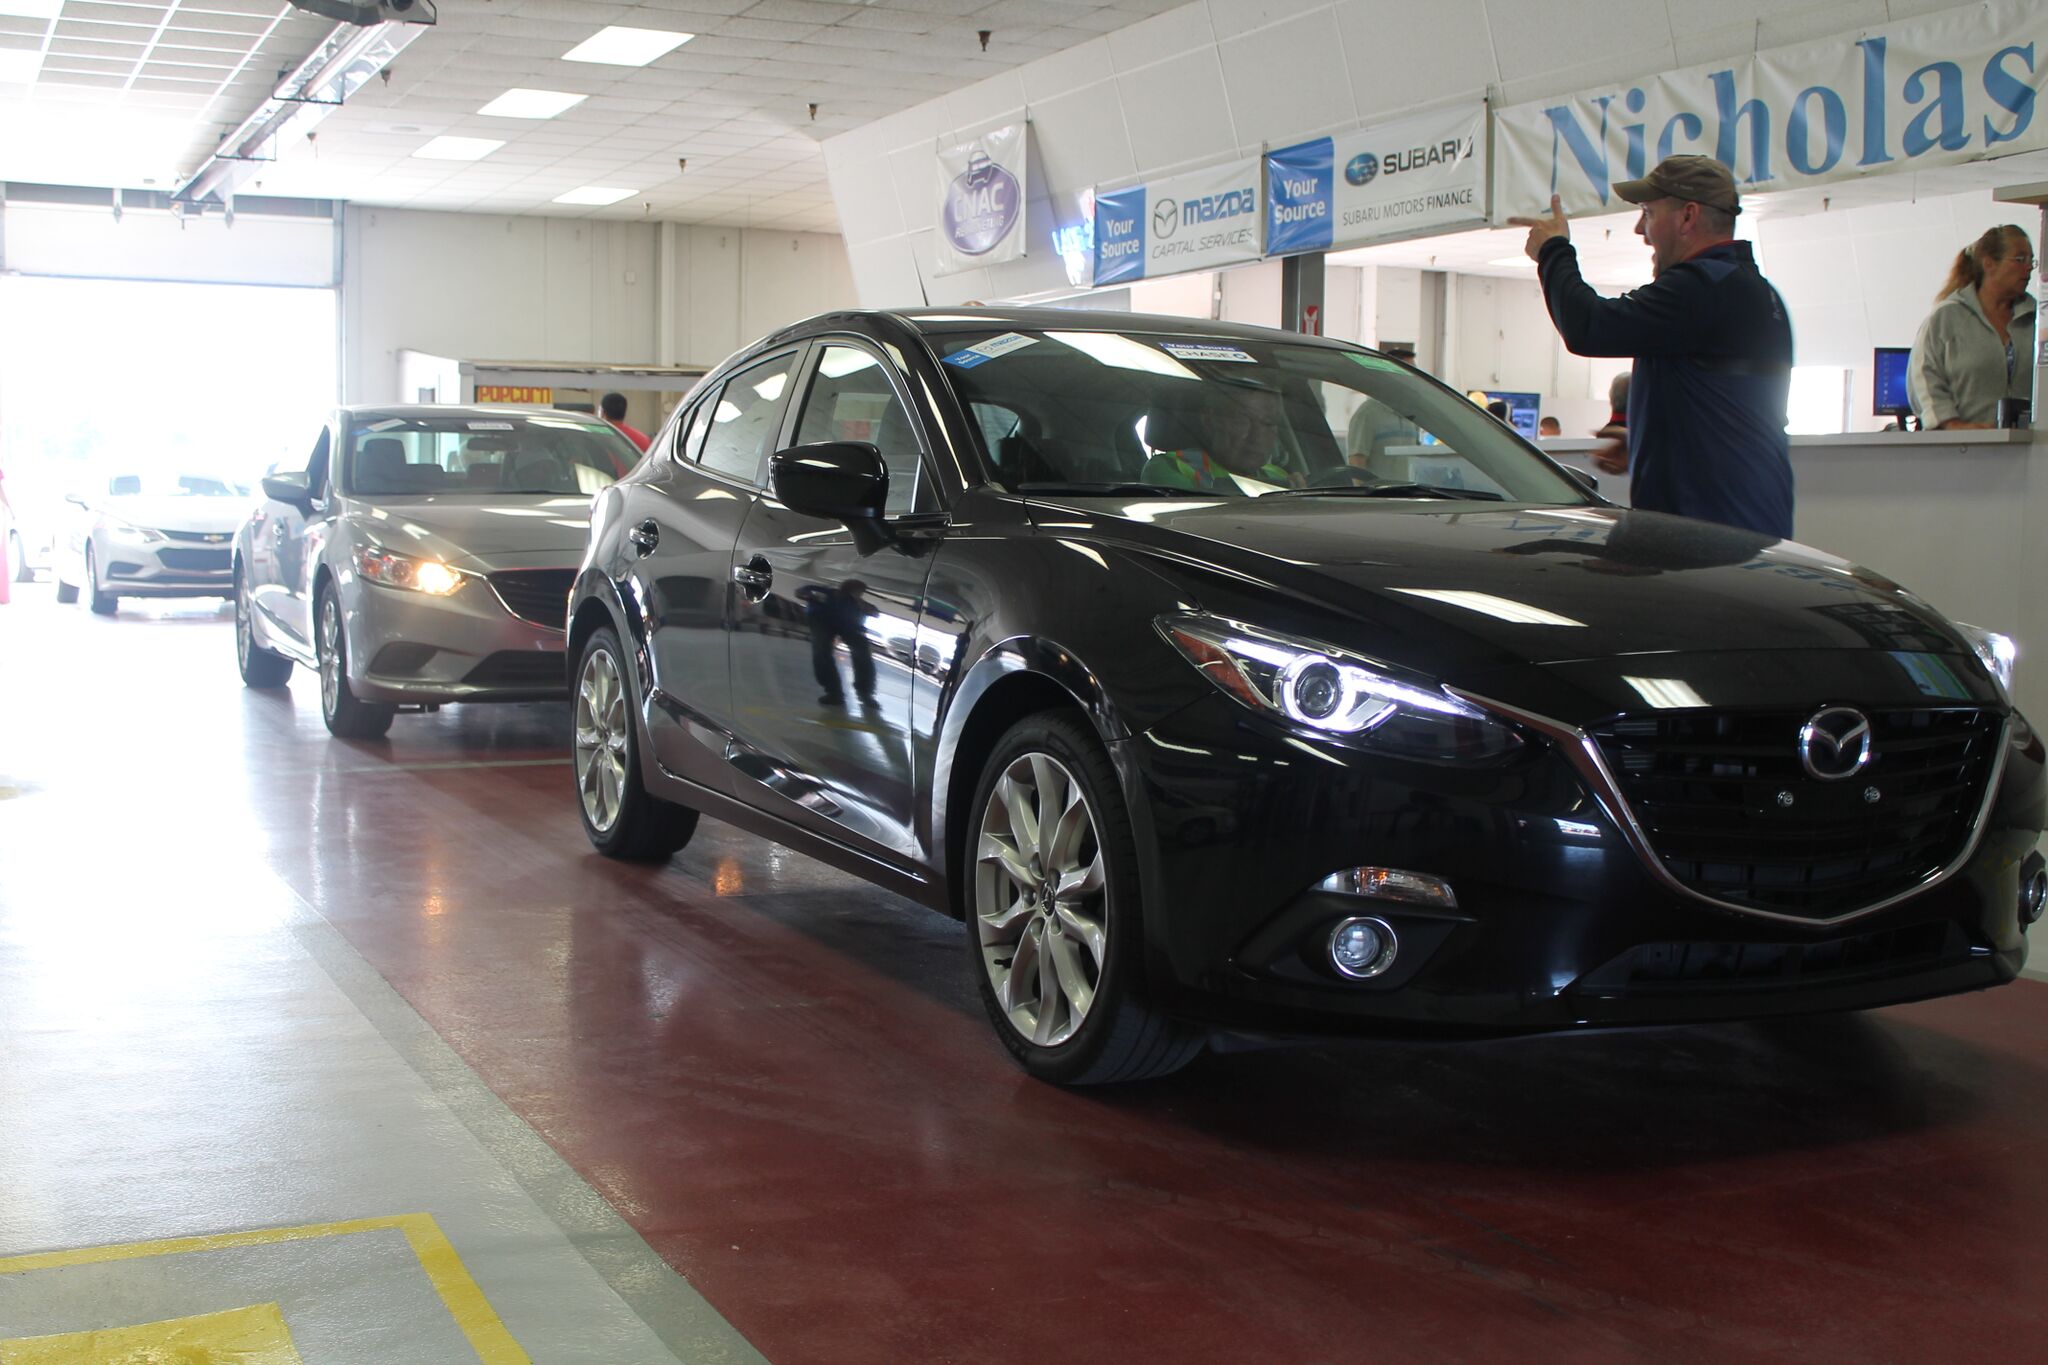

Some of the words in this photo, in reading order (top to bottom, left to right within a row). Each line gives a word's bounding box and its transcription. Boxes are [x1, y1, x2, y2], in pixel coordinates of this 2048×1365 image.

[1541, 36, 2036, 213] Nicholas
[1384, 136, 1474, 176] SUBARU
[1283, 177, 1318, 199] Your
[1275, 200, 1326, 225] Source
[1343, 207, 1380, 226] SUBARU
[1383, 197, 1424, 220] MOTORS
[1426, 188, 1473, 210] FINANCE
[1106, 218, 1134, 238] Your
[1101, 239, 1140, 259] Source
[1151, 239, 1196, 260] CAPITAL
[1198, 227, 1254, 251] SERVICES
